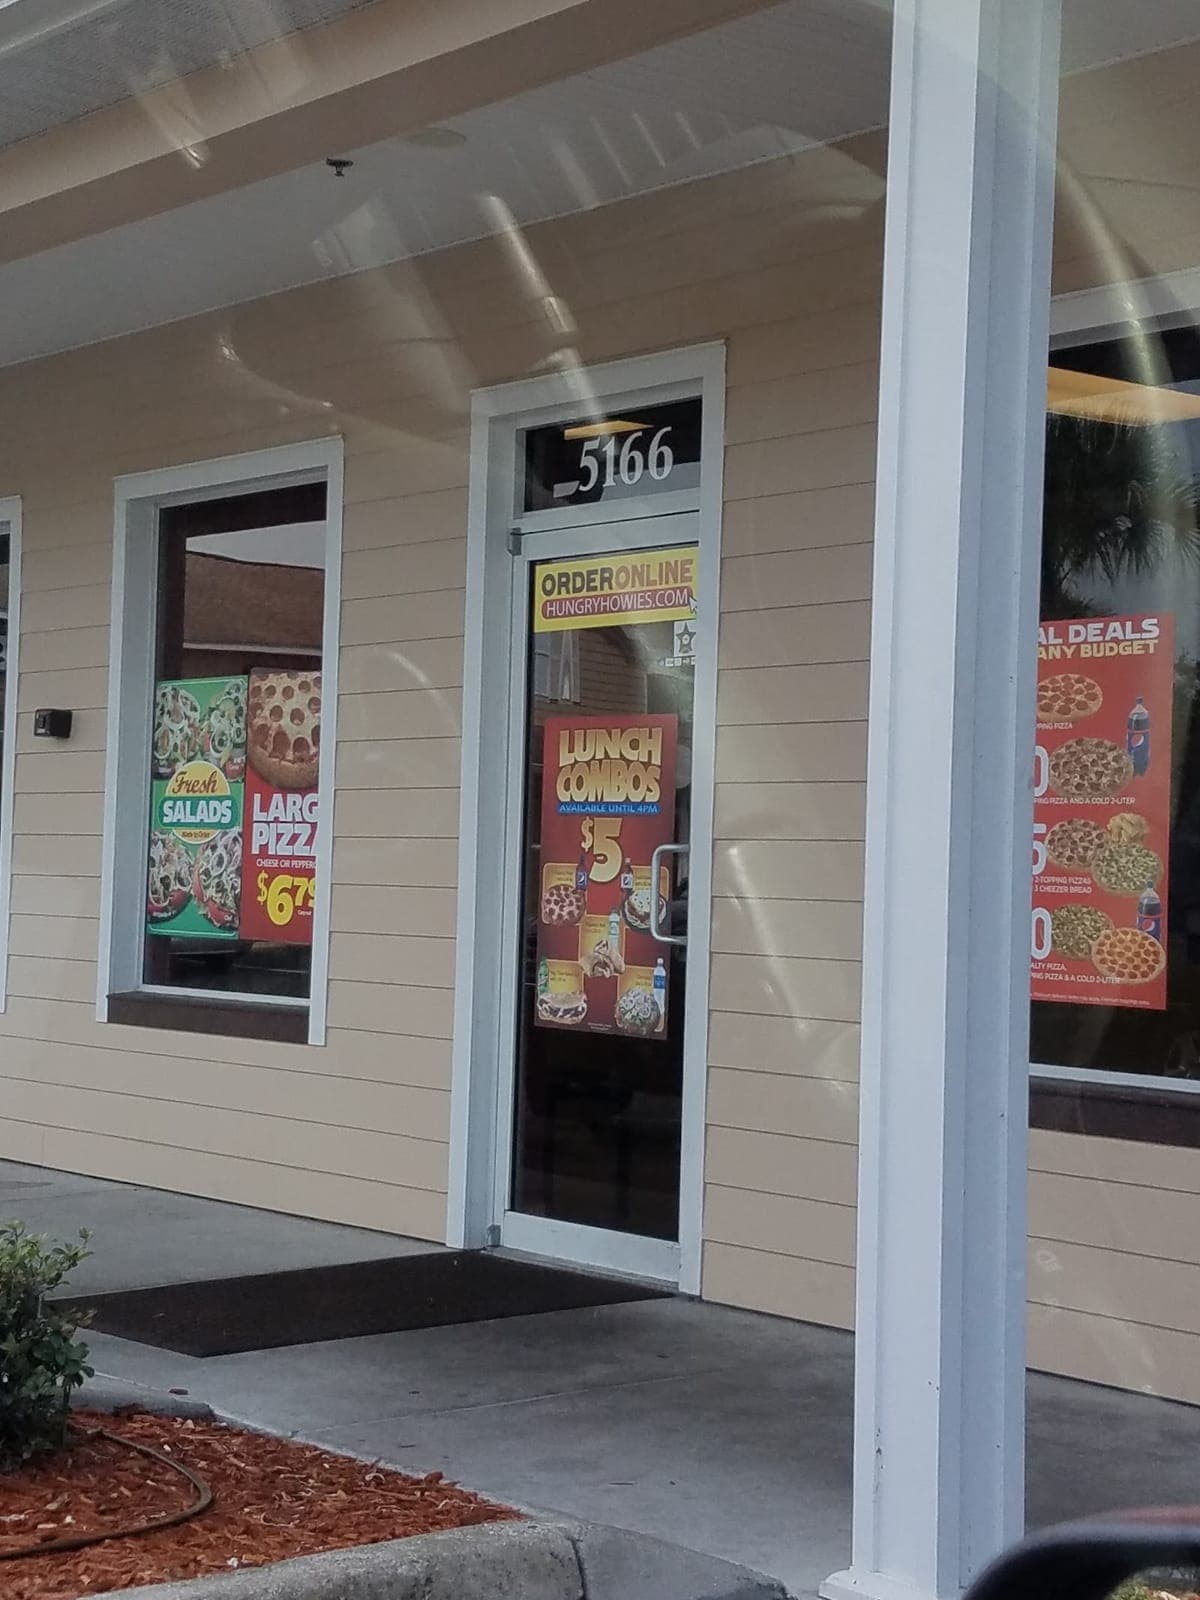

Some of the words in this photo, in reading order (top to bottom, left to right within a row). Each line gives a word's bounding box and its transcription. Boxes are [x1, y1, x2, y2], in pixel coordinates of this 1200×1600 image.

[578, 426, 675, 492] 5166
[545, 588, 689, 617] HUNGRYHOWIES.COM
[1038, 626, 1063, 645] AL
[1068, 618, 1160, 643] DEALS
[1037, 644, 1077, 660] ANY
[1080, 639, 1159, 658] BUDGET
[558, 727, 662, 767] LUNCH
[172, 770, 218, 793] Fresh
[556, 759, 661, 802] COMBOS
[1034, 745, 1049, 797] 0
[163, 799, 232, 824] SALADS
[252, 793, 319, 823] LARG
[559, 804, 606, 813] AVAILABLE
[608, 804, 635, 813] UNTIL
[637, 804, 658, 813] 4PM
[256, 858, 279, 868] CHEESE
[280, 859, 291, 868] OR
[581, 815, 623, 883] $5
[1032, 823, 1047, 875] 5
[1032, 907, 1052, 960] 0
[1077, 975, 1095, 983] COLD
